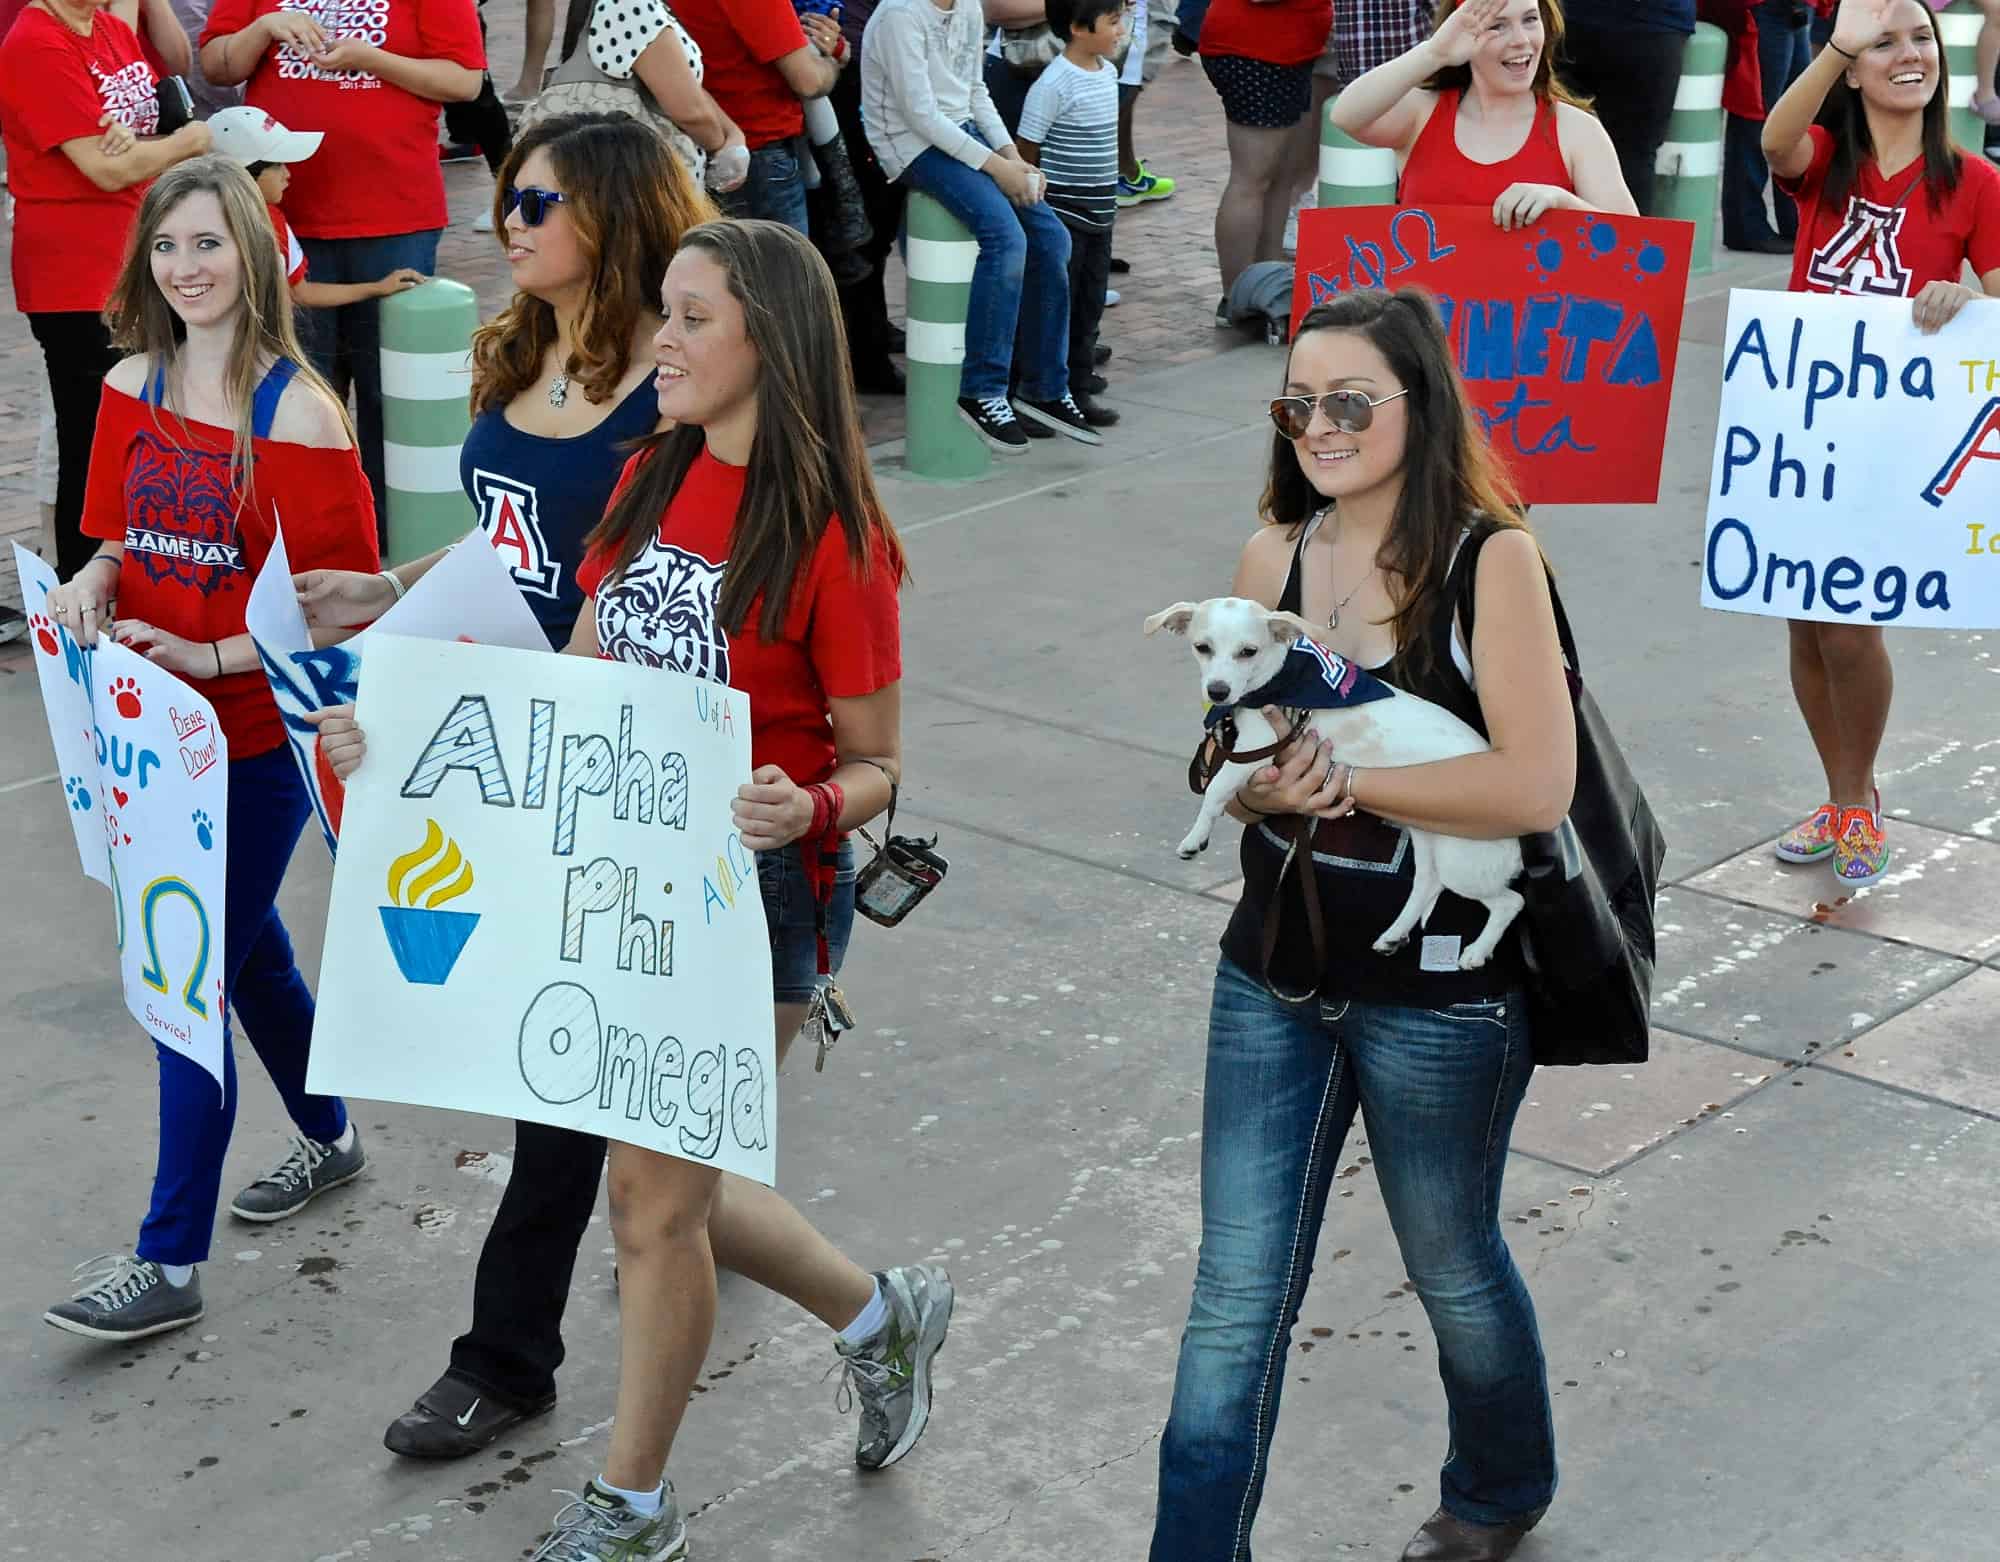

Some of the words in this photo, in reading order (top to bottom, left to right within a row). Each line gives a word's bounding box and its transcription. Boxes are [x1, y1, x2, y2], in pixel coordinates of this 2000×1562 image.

[1807, 196, 1913, 297] A
[1434, 291, 1662, 387] HETA
[1724, 317, 1935, 430] Alpha
[1720, 425, 1836, 502] Phi
[473, 467, 561, 600] A
[1706, 517, 1951, 622] Omega
[696, 686, 708, 723] U
[722, 697, 736, 738] A
[399, 694, 689, 857] Alpha
[559, 856, 675, 978] Phi
[145, 1002, 193, 1045] Service!
[517, 980, 769, 1161] Omega
